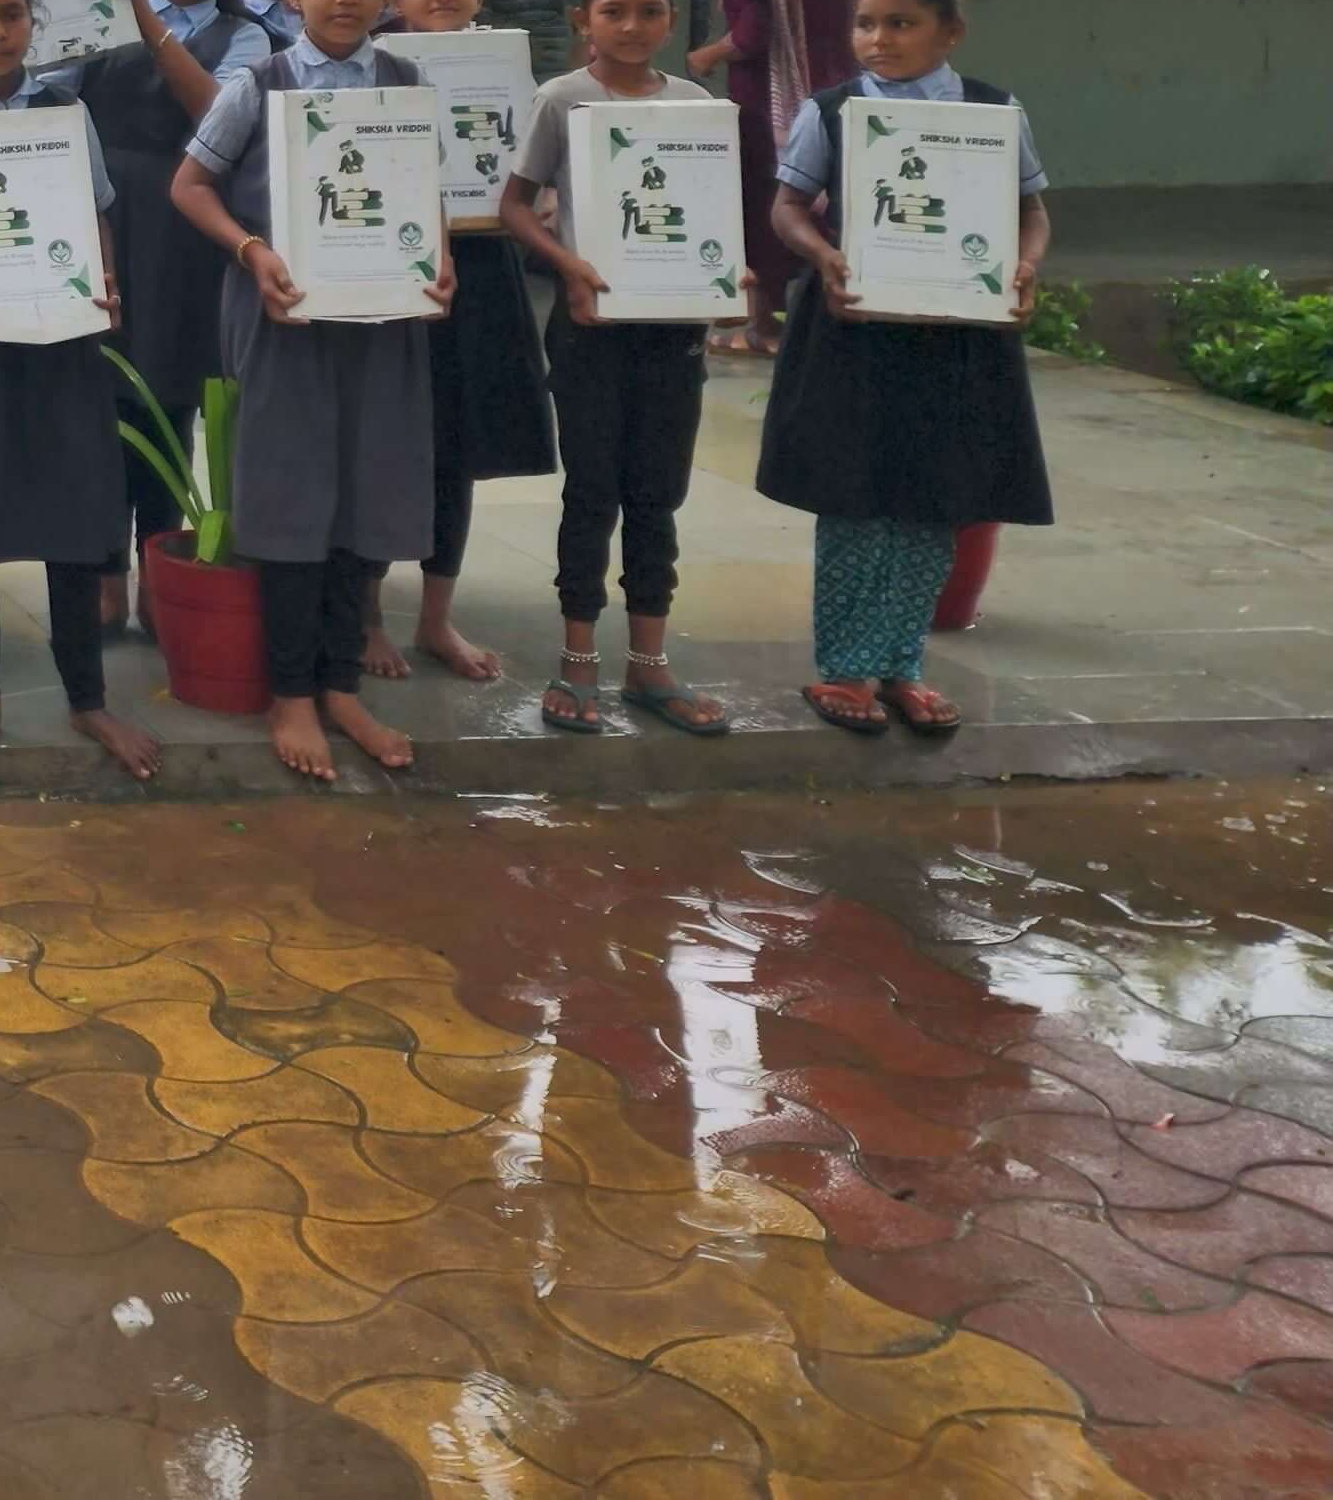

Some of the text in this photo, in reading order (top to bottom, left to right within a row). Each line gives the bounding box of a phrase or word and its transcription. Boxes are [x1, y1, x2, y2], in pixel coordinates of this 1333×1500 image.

[356, 124, 431, 134] SHIKSHA VRIDDHI
[920, 134, 1005, 147] SHIKSHA VRIDDHI
[35, 141, 70, 151] VRIDDHI
[657, 143, 729, 152] SHIKSHA VRIDDHI
